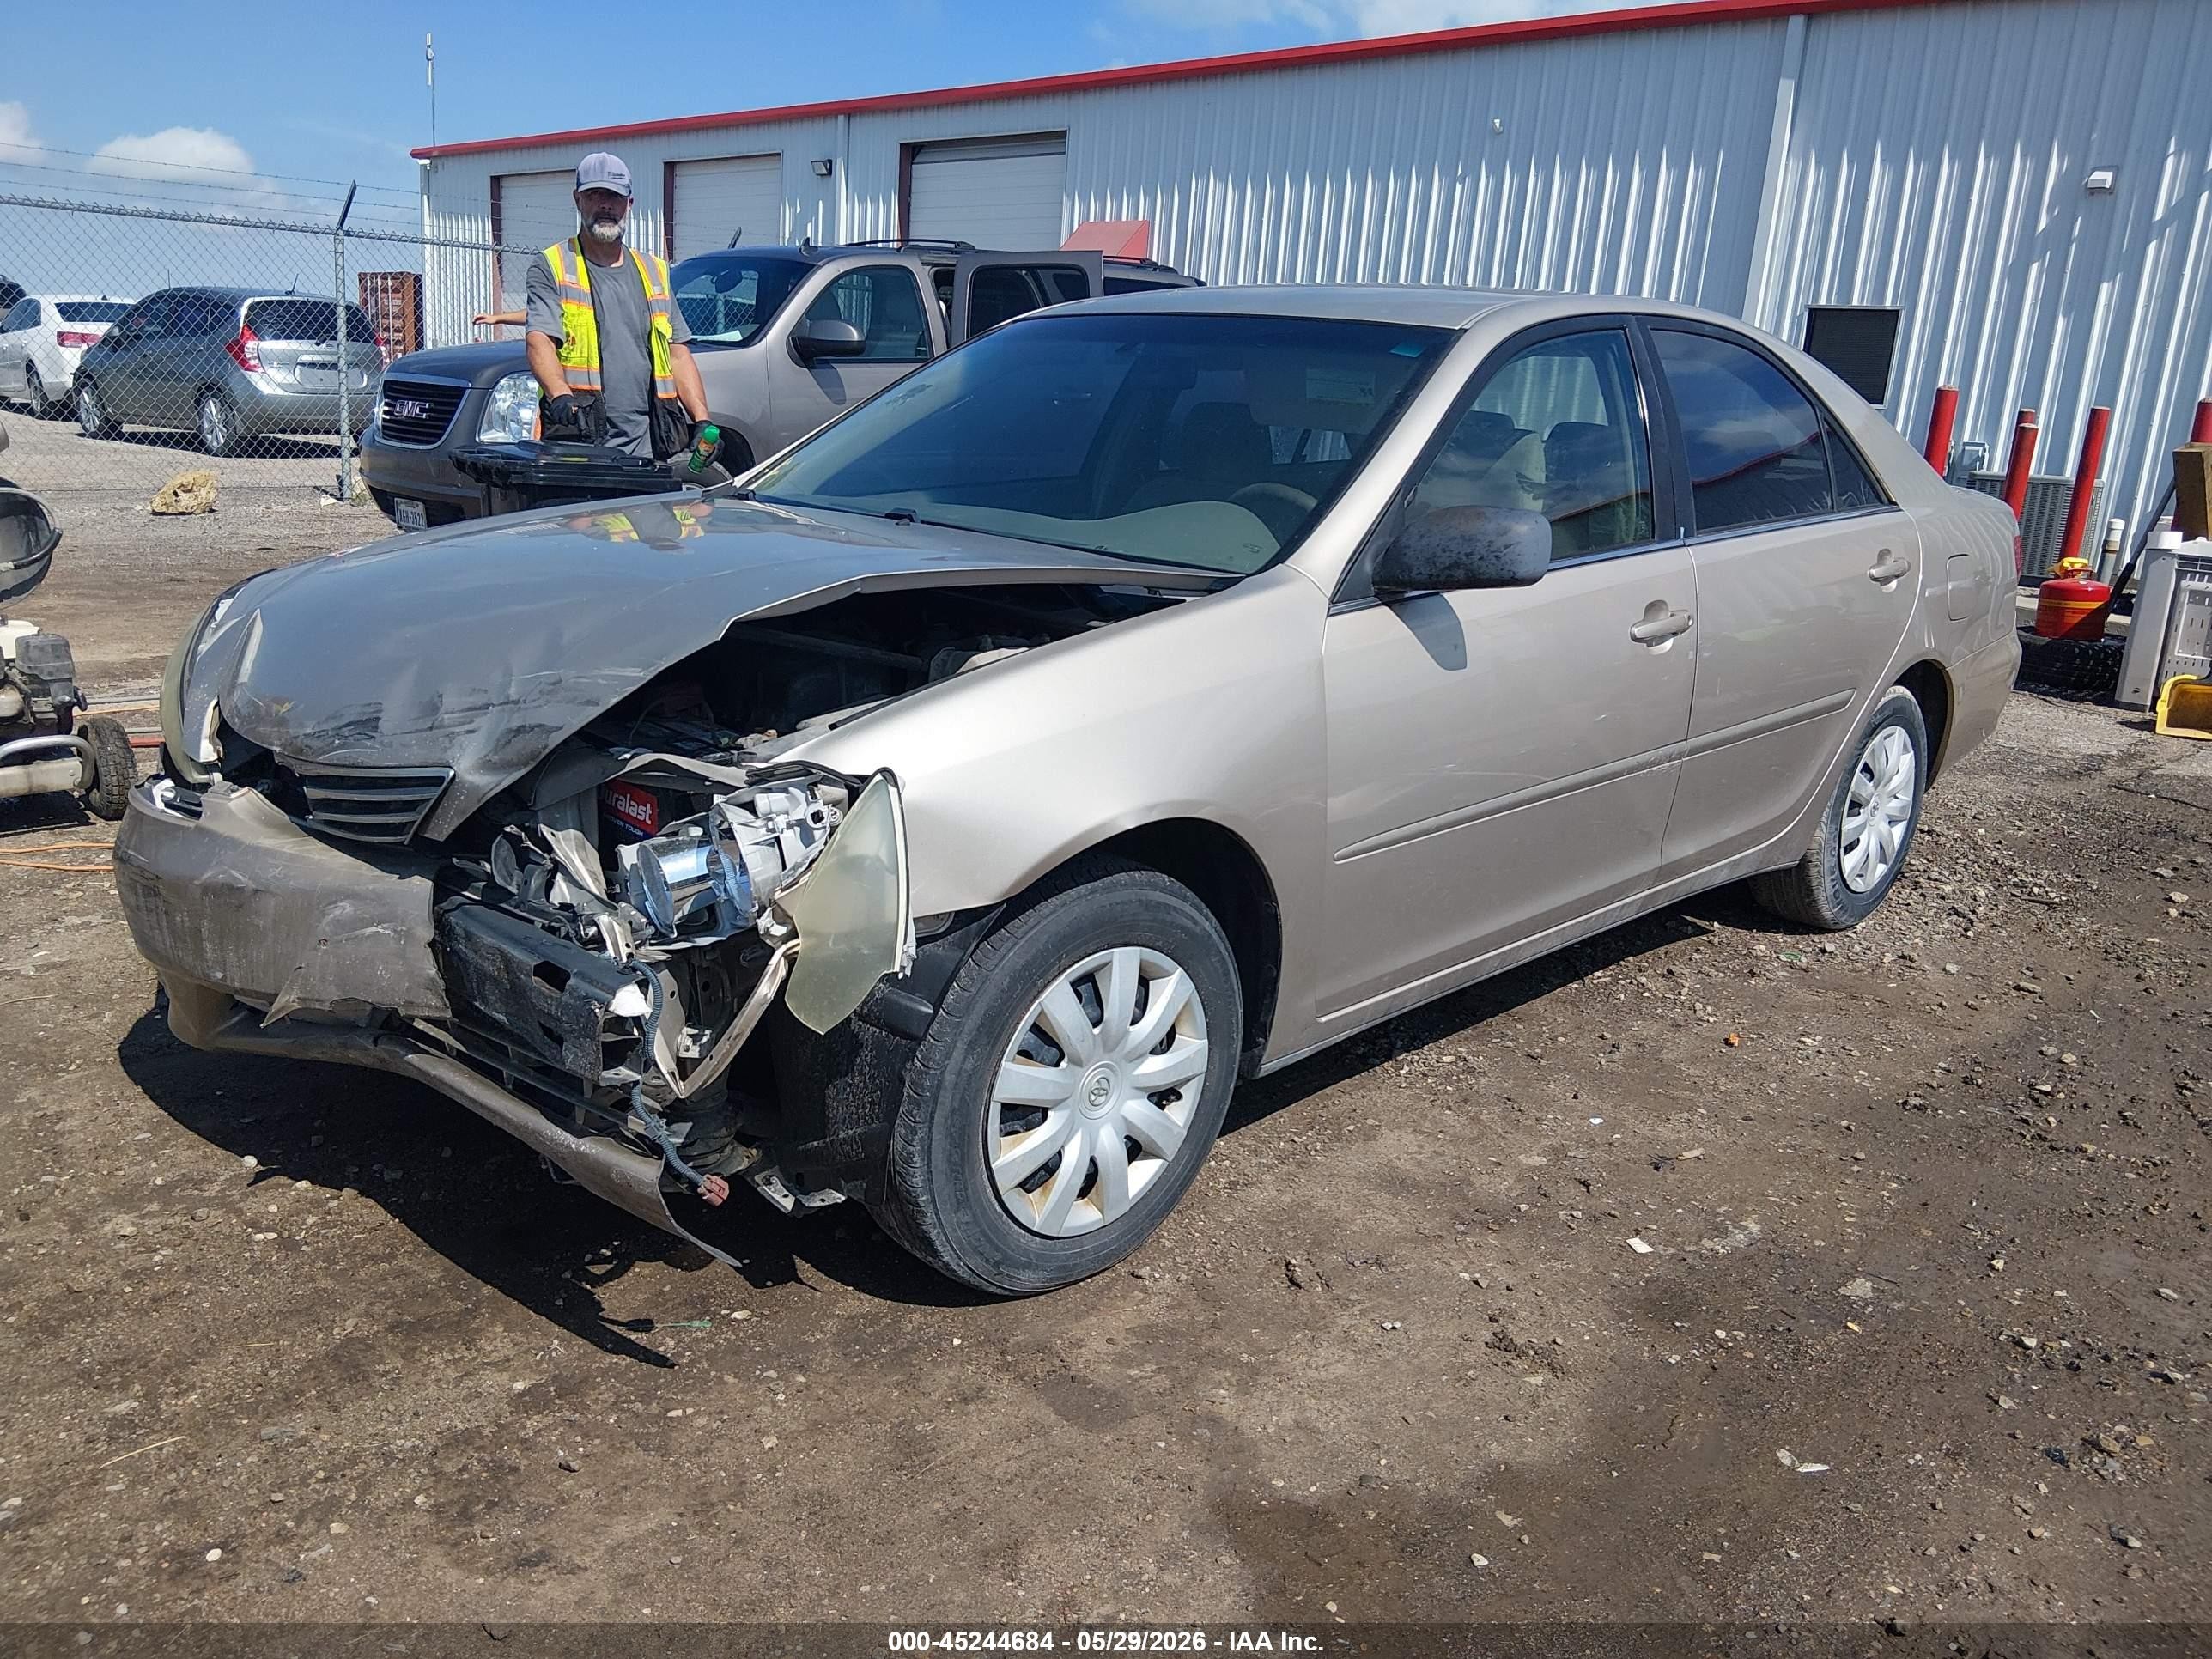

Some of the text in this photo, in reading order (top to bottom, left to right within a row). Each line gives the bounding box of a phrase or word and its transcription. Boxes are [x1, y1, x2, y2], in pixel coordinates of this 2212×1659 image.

[395, 399, 428, 418] GMC
[605, 790, 652, 824] uralast
[625, 823, 644, 836] TOUGH
